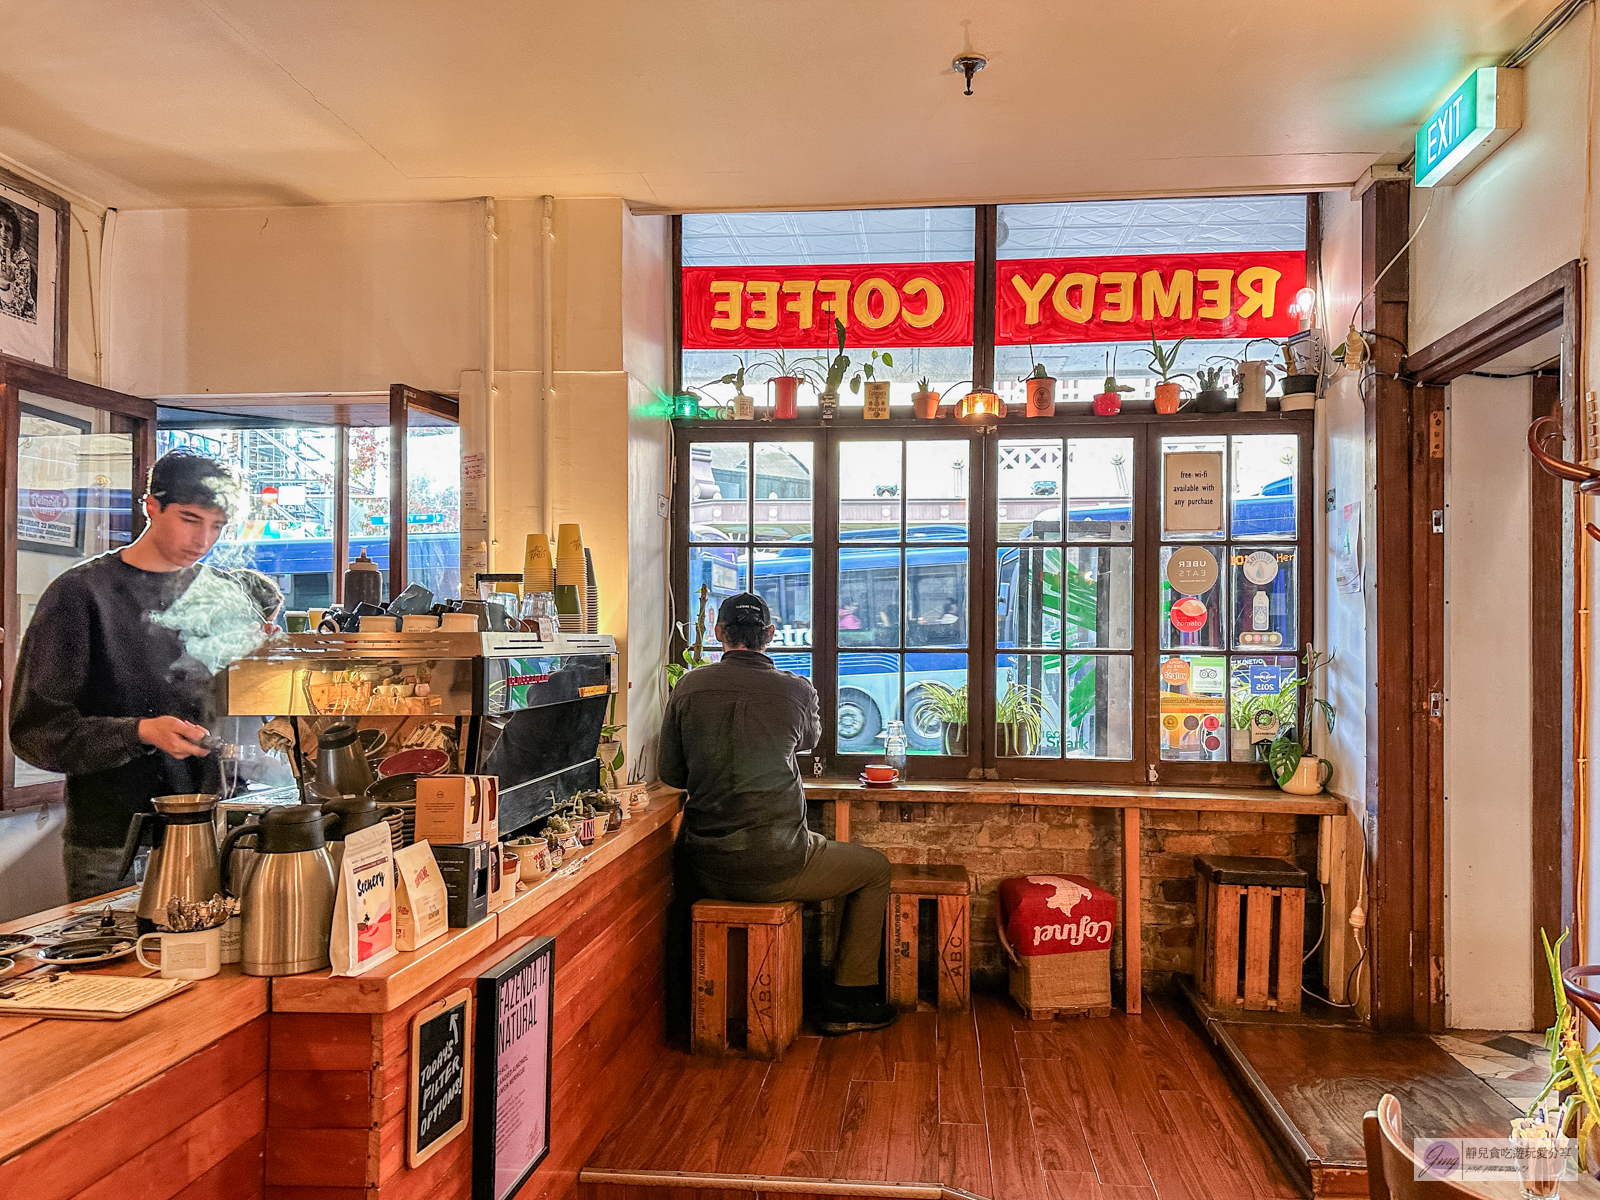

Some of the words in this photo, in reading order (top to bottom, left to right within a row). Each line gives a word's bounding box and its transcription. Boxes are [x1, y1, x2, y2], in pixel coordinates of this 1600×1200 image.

[1427, 94, 1463, 166] EXIT
[1173, 483, 1200, 493] available
[1201, 483, 1215, 493] with
[1180, 470, 1193, 480] free
[1194, 470, 1209, 480] wi-fi
[1174, 498, 1186, 508] any
[1187, 497, 1214, 508] purchase
[772, 624, 812, 646] etr
[1176, 618, 1202, 628] zomato
[357, 870, 386, 898] Scenery
[1033, 919, 1112, 947] Cofinet
[949, 934, 963, 977] ABC
[498, 961, 538, 1019] FAZENDA
[758, 971, 773, 1018] ABC
[498, 995, 538, 1057] NATURAL
[420, 1039, 454, 1087] TODAY'S
[421, 1054, 460, 1111] FILTER
[420, 1067, 463, 1137] OPTIONS!
